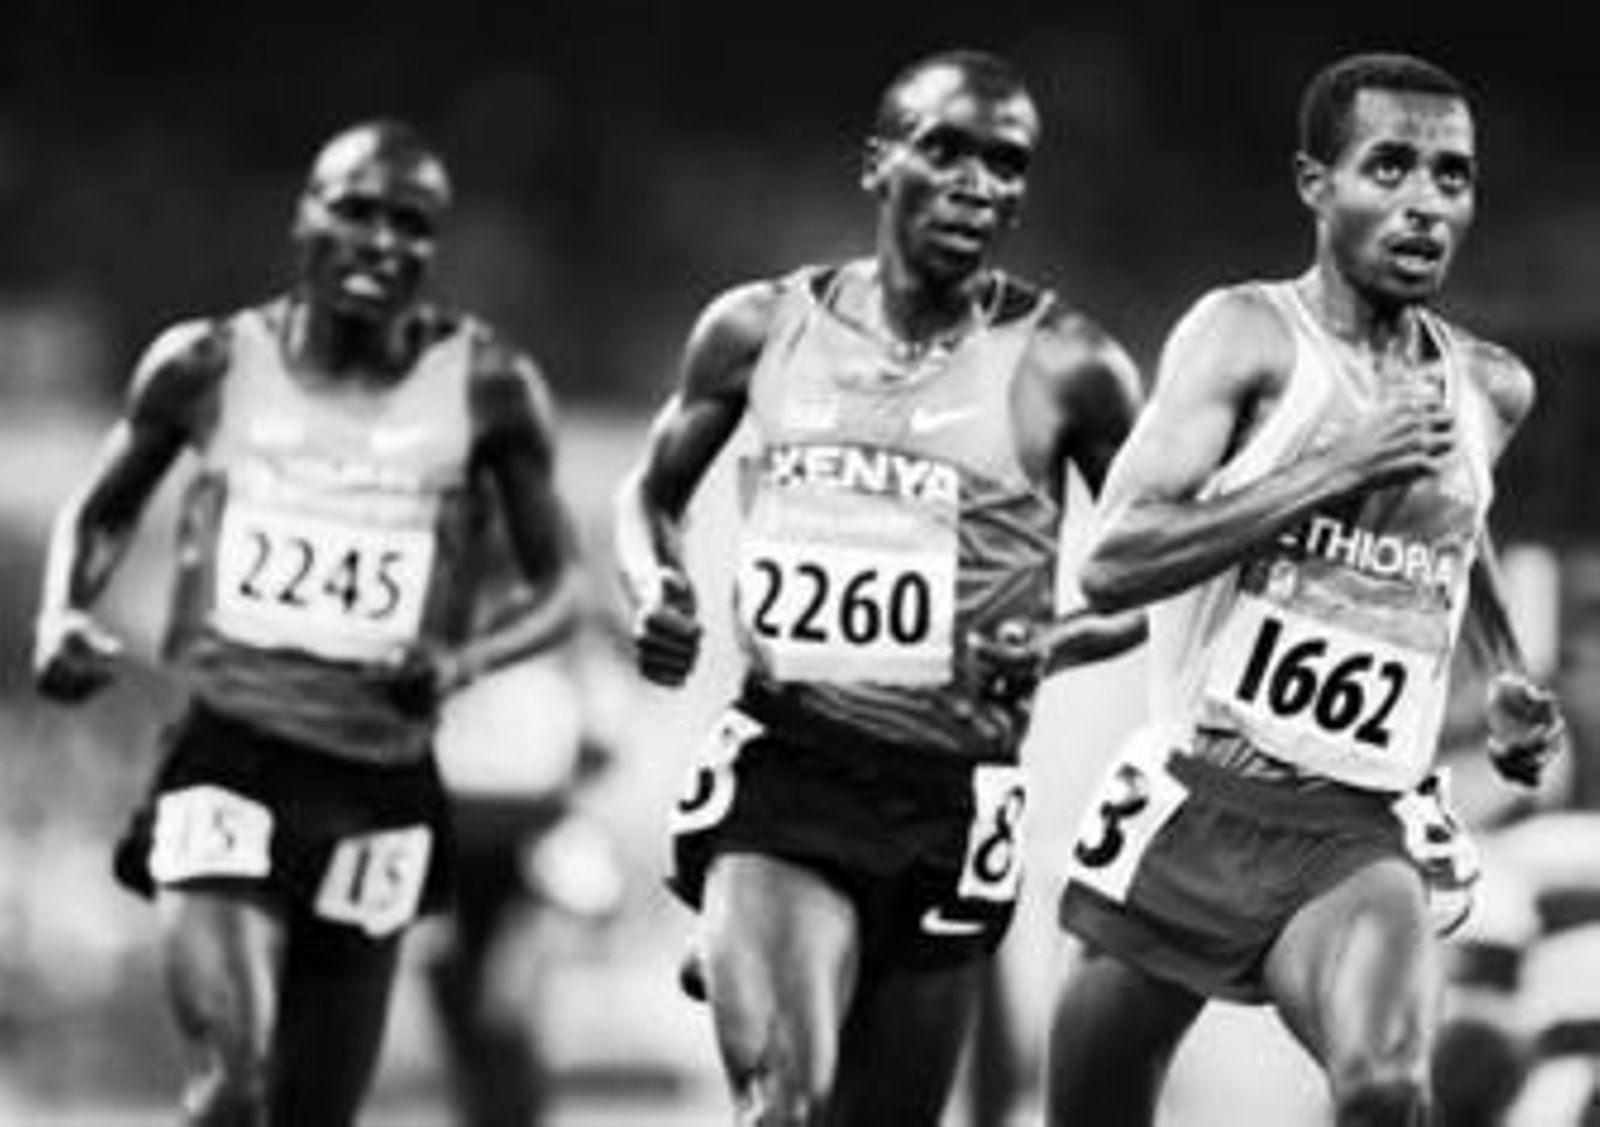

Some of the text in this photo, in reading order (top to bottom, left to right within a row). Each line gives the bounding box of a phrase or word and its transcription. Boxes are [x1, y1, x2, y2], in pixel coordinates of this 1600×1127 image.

[771, 446, 958, 500] KENYA
[238, 532, 403, 619] 2245
[752, 559, 931, 645] 2260
[1237, 618, 1407, 748] 1662
[1074, 763, 1148, 869] 3
